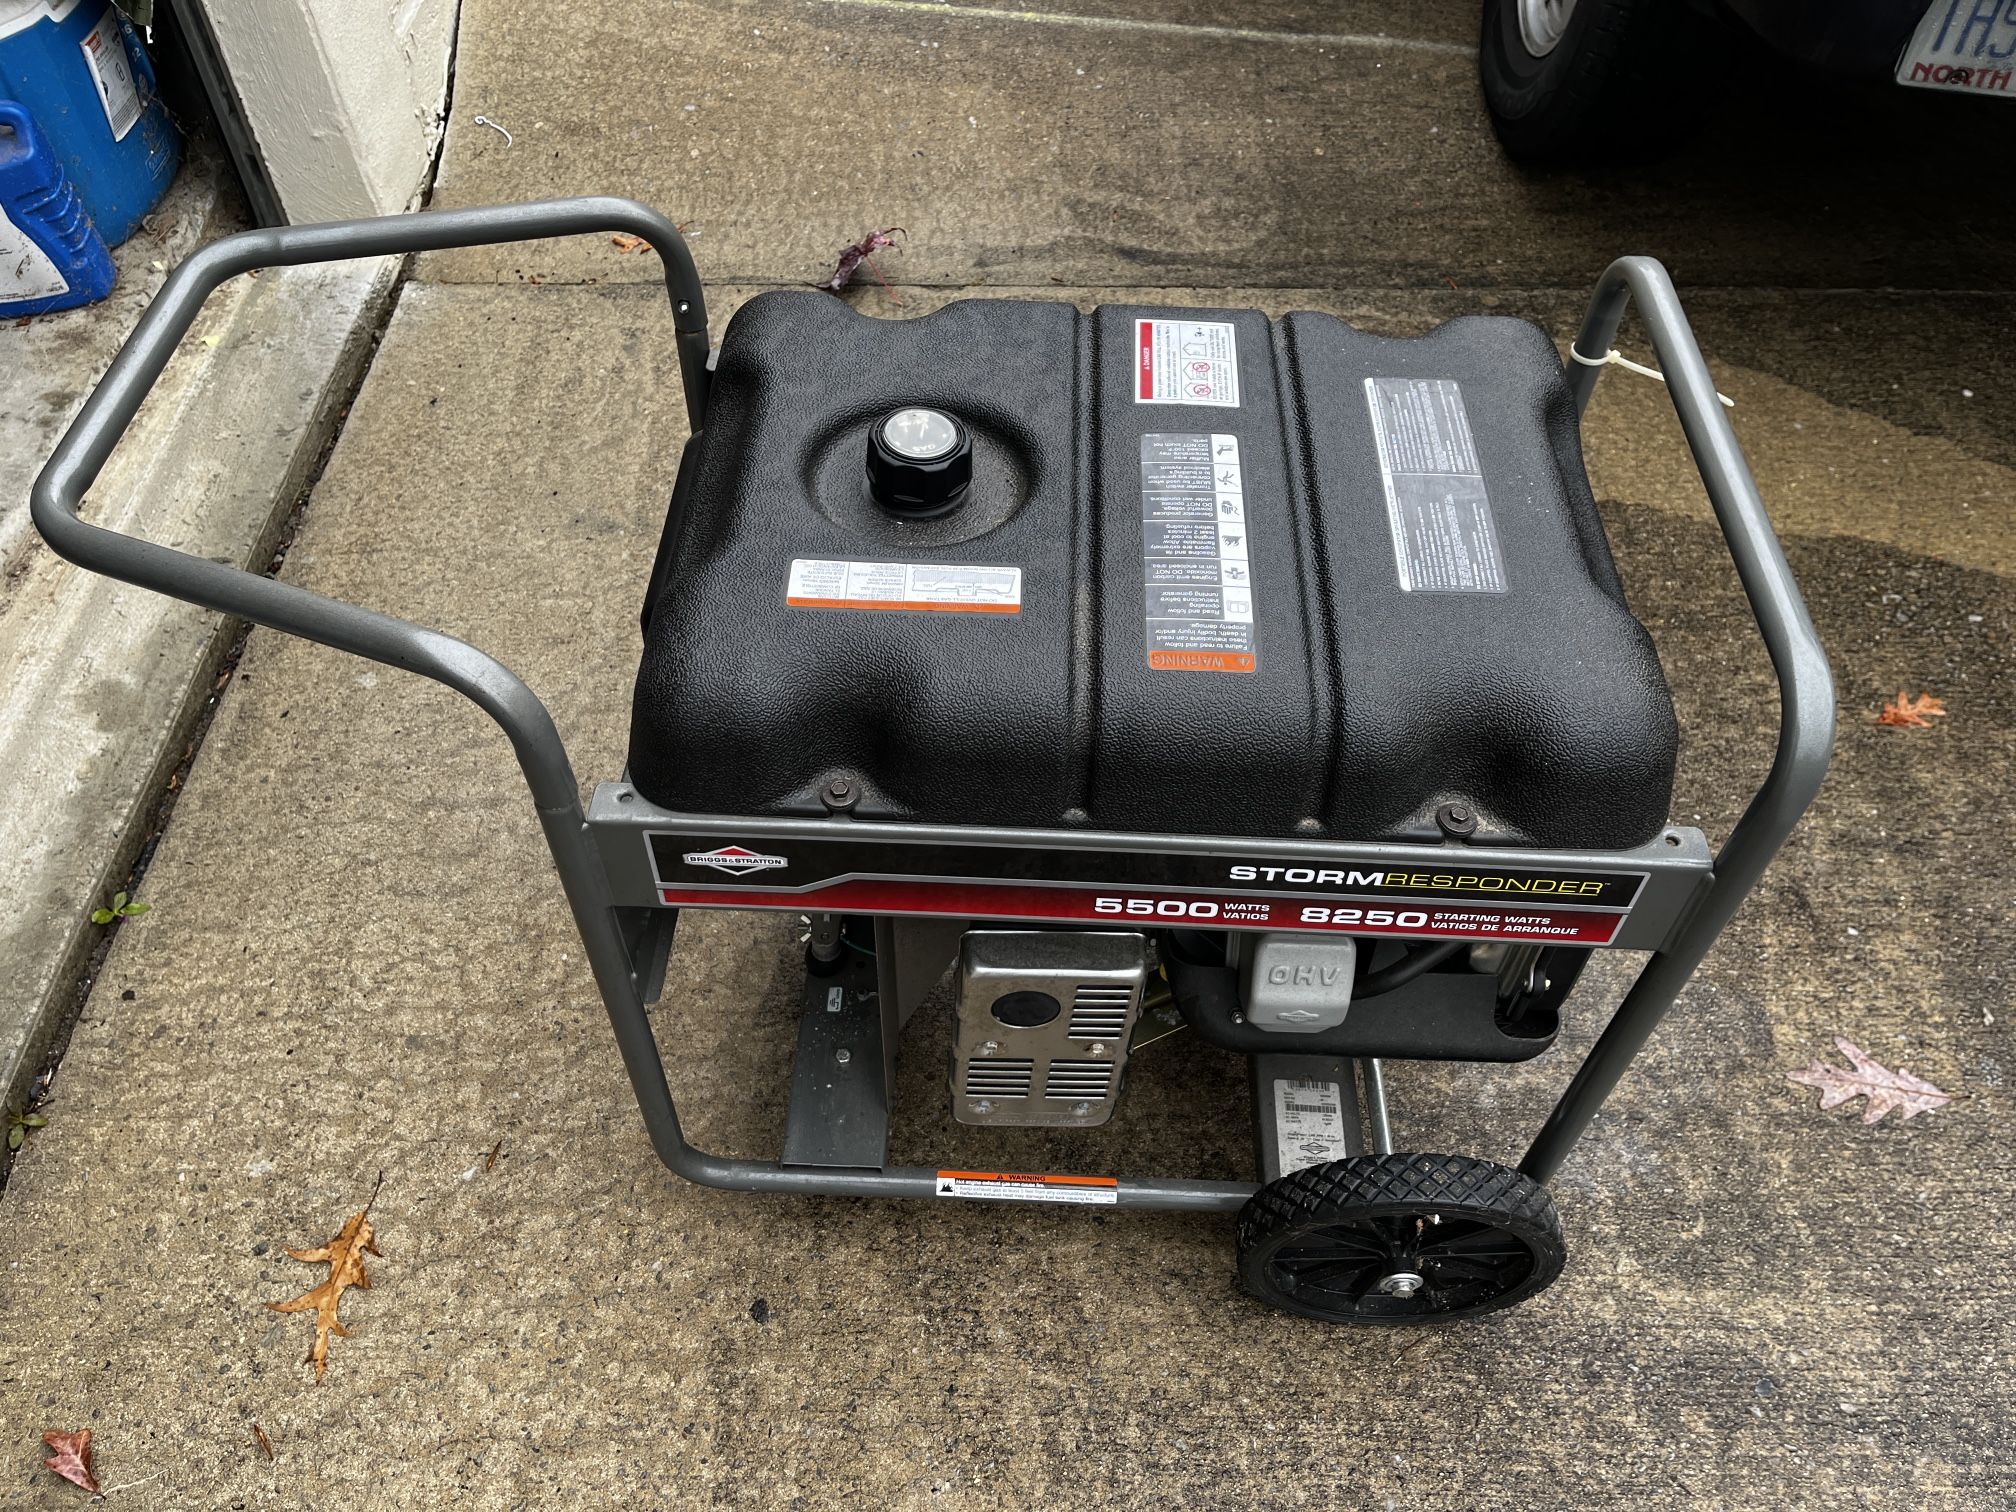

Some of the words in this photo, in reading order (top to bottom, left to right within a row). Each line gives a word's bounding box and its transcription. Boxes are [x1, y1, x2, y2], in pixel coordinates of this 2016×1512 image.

[1152, 654, 1224, 668] WARNING
[1094, 897, 1219, 919] 5500
[1223, 902, 1271, 913] WATTS
[1222, 911, 1270, 921] VATIOS
[1300, 906, 1428, 929] 8250
[1433, 912, 1501, 924] STARTING
[1503, 914, 1552, 926] WATTS
[1430, 920, 1479, 931] VATIOS
[1481, 923, 1500, 933] DE
[1502, 924, 1579, 936] ARRANQUE
[1268, 964, 1341, 986] OHV
[1009, 1174, 1046, 1182] WARNING
